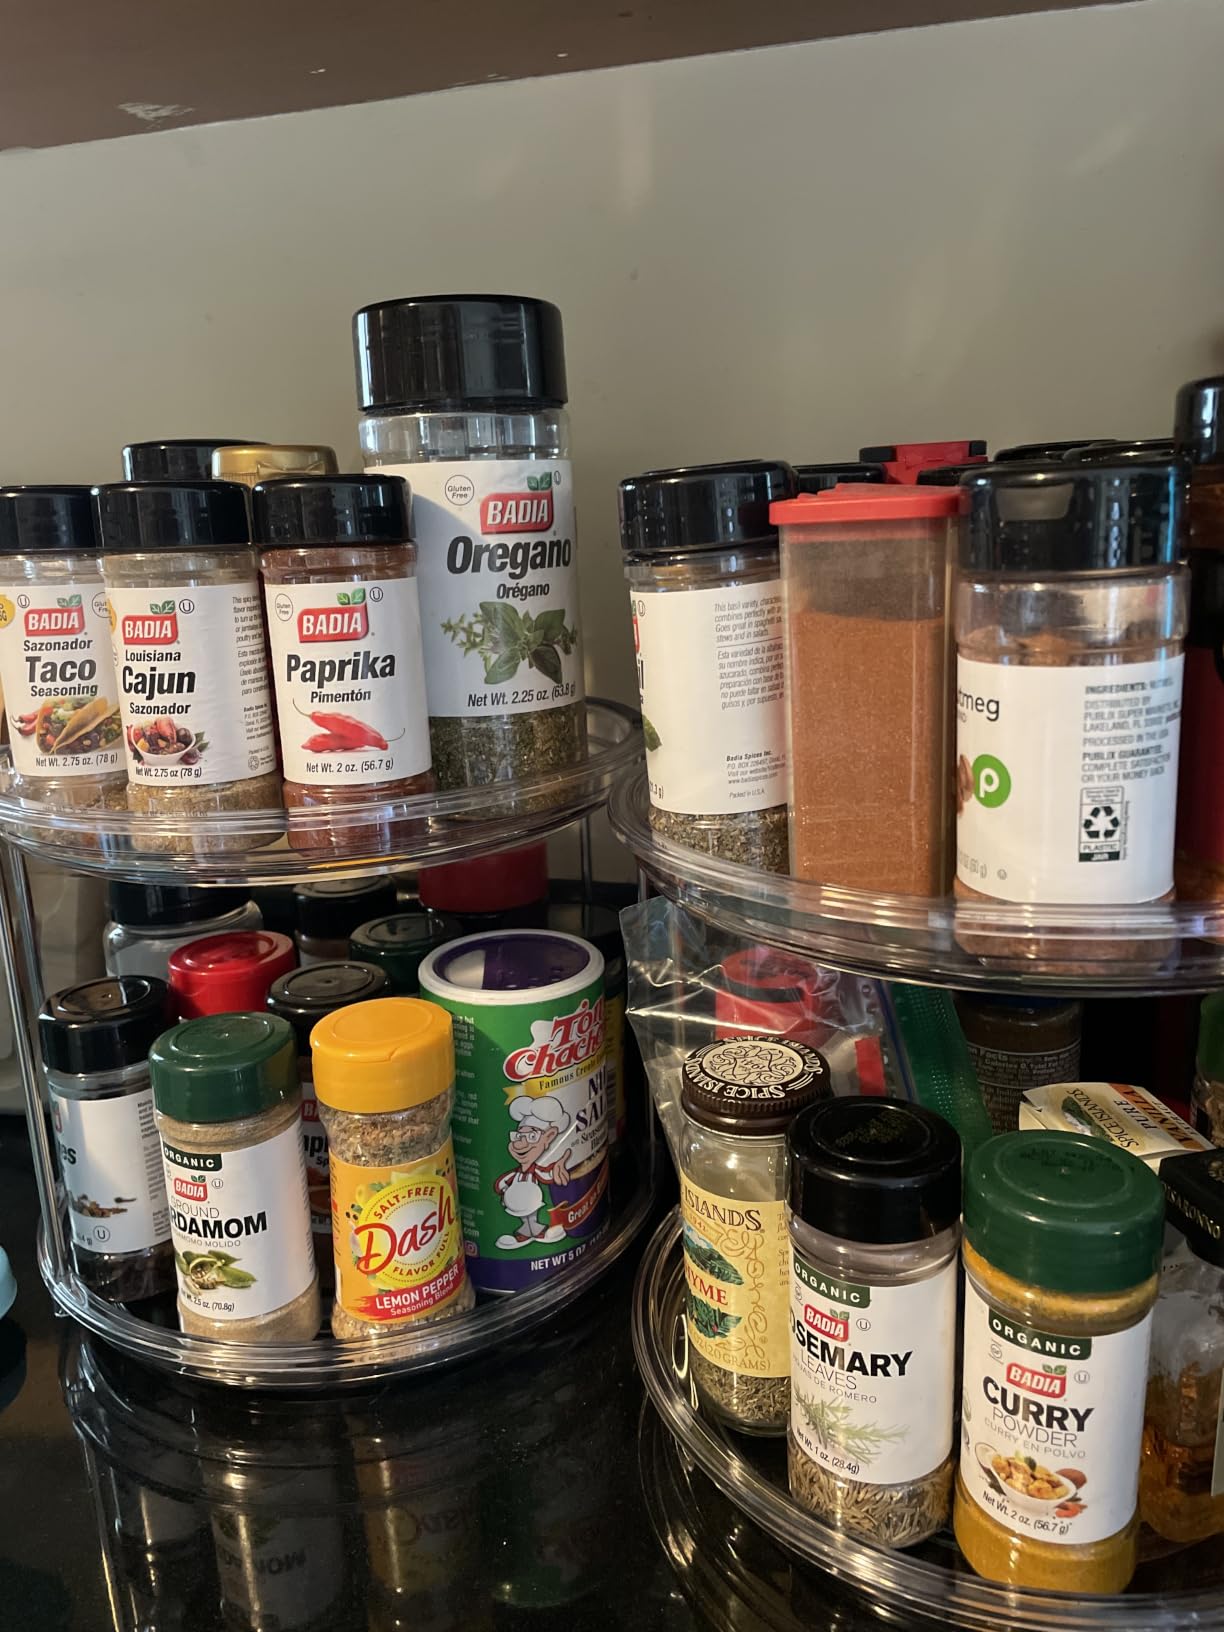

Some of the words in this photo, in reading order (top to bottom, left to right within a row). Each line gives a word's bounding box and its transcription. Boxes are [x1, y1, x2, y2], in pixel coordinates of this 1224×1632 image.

[488, 499, 548, 525] BADIA
[447, 536, 571, 580] Oregano
[497, 582, 550, 601] Orégano
[715, 604, 726, 612] This
[728, 602, 740, 611] basil
[715, 613, 742, 622] combines
[28, 612, 79, 630] BADIA
[125, 620, 172, 639] BADIA
[303, 613, 362, 635] BADIA
[716, 624, 730, 633] Goes
[24, 638, 93, 651] Sazonador
[734, 631, 745, 640] and
[747, 631, 751, 639] in
[126, 650, 181, 661] Louisiana
[718, 651, 729, 660] Esta
[727, 659, 748, 668] nombre
[26, 656, 97, 683] Taco
[287, 651, 396, 689] Paprika
[31, 684, 98, 697] Seasoning
[123, 666, 196, 701] Cajun
[730, 689, 746, 699] puede
[311, 689, 371, 703] Pimentón
[468, 694, 488, 707] Net
[491, 692, 508, 706] Wt.
[511, 690, 534, 704] 2.25
[130, 703, 191, 715] Sazonador
[1084, 711, 1115, 721] PUBLIX
[1118, 708, 1143, 719] SUPER
[1083, 736, 1135, 747] PROCESSED
[36, 758, 46, 767] Net
[63, 757, 80, 766] 2.75
[83, 757, 94, 765] oz.
[96, 754, 109, 766] (78
[111, 753, 118, 765] g)
[307, 762, 319, 773] Net
[321, 763, 334, 772] Wt.
[337, 763, 342, 772] 2
[345, 764, 358, 772] oz.
[361, 759, 383, 773] (56.7
[386, 758, 394, 770] g)
[1082, 761, 1128, 772] COMPLETE
[1083, 752, 1115, 761] PUBLIX
[154, 768, 168, 778] 2.75
[181, 768, 192, 779] (78
[194, 768, 202, 778] g)
[1082, 774, 1094, 783] OR
[1097, 773, 1120, 782] YOUR
[540, 1069, 574, 1091] Famous
[685, 1058, 725, 1093] ISLANDS
[724, 1086, 786, 1099] SPICE
[1066, 1088, 1109, 1122] ISLANDS
[1115, 1101, 1158, 1130] PURE
[1123, 1090, 1193, 1144] VANILLA
[1106, 1120, 1139, 1149] SPICE
[165, 1148, 214, 1168] ORGANIC
[176, 1180, 204, 1198] BADIA
[171, 1196, 220, 1219] GROUND
[374, 1187, 436, 1219] SALT-FREE
[568, 1202, 589, 1223] Great
[685, 1189, 762, 1231] ISLANDS
[354, 1185, 455, 1275] Dash
[205, 1240, 241, 1248] MOLIDO
[393, 1260, 435, 1276] FLAVOR
[531, 1259, 550, 1271] NET
[552, 1255, 567, 1266] WT
[569, 1250, 574, 1260] 5
[376, 1291, 419, 1309] LEMON
[422, 1264, 459, 1298] PEPPER
[796, 1264, 860, 1303] ORGANIC
[391, 1296, 434, 1316] Seasoning
[435, 1283, 453, 1300] Blend
[807, 1308, 844, 1338] BADIA
[993, 1319, 1081, 1356] ORGANIC
[723, 1354, 771, 1371] GRAMS)
[801, 1349, 857, 1390] LEAVES
[814, 1376, 826, 1390] DE
[830, 1384, 877, 1403] ROMERO
[1010, 1366, 1061, 1394] BADIA
[983, 1376, 1095, 1432] CURRY
[993, 1407, 1077, 1448] POWDER
[985, 1418, 1019, 1444] CURRY
[1024, 1441, 1042, 1453] EN
[1044, 1447, 1086, 1459] POLVO
[820, 1453, 829, 1462] oz.
[832, 1457, 860, 1475] (28.4g)
[983, 1490, 995, 1509] Net
[997, 1502, 1009, 1516] Wt.
[1011, 1510, 1017, 1520] 2
[1019, 1516, 1030, 1526] oz.
[1034, 1520, 1058, 1532] (56.7
[1060, 1525, 1069, 1535] g)
